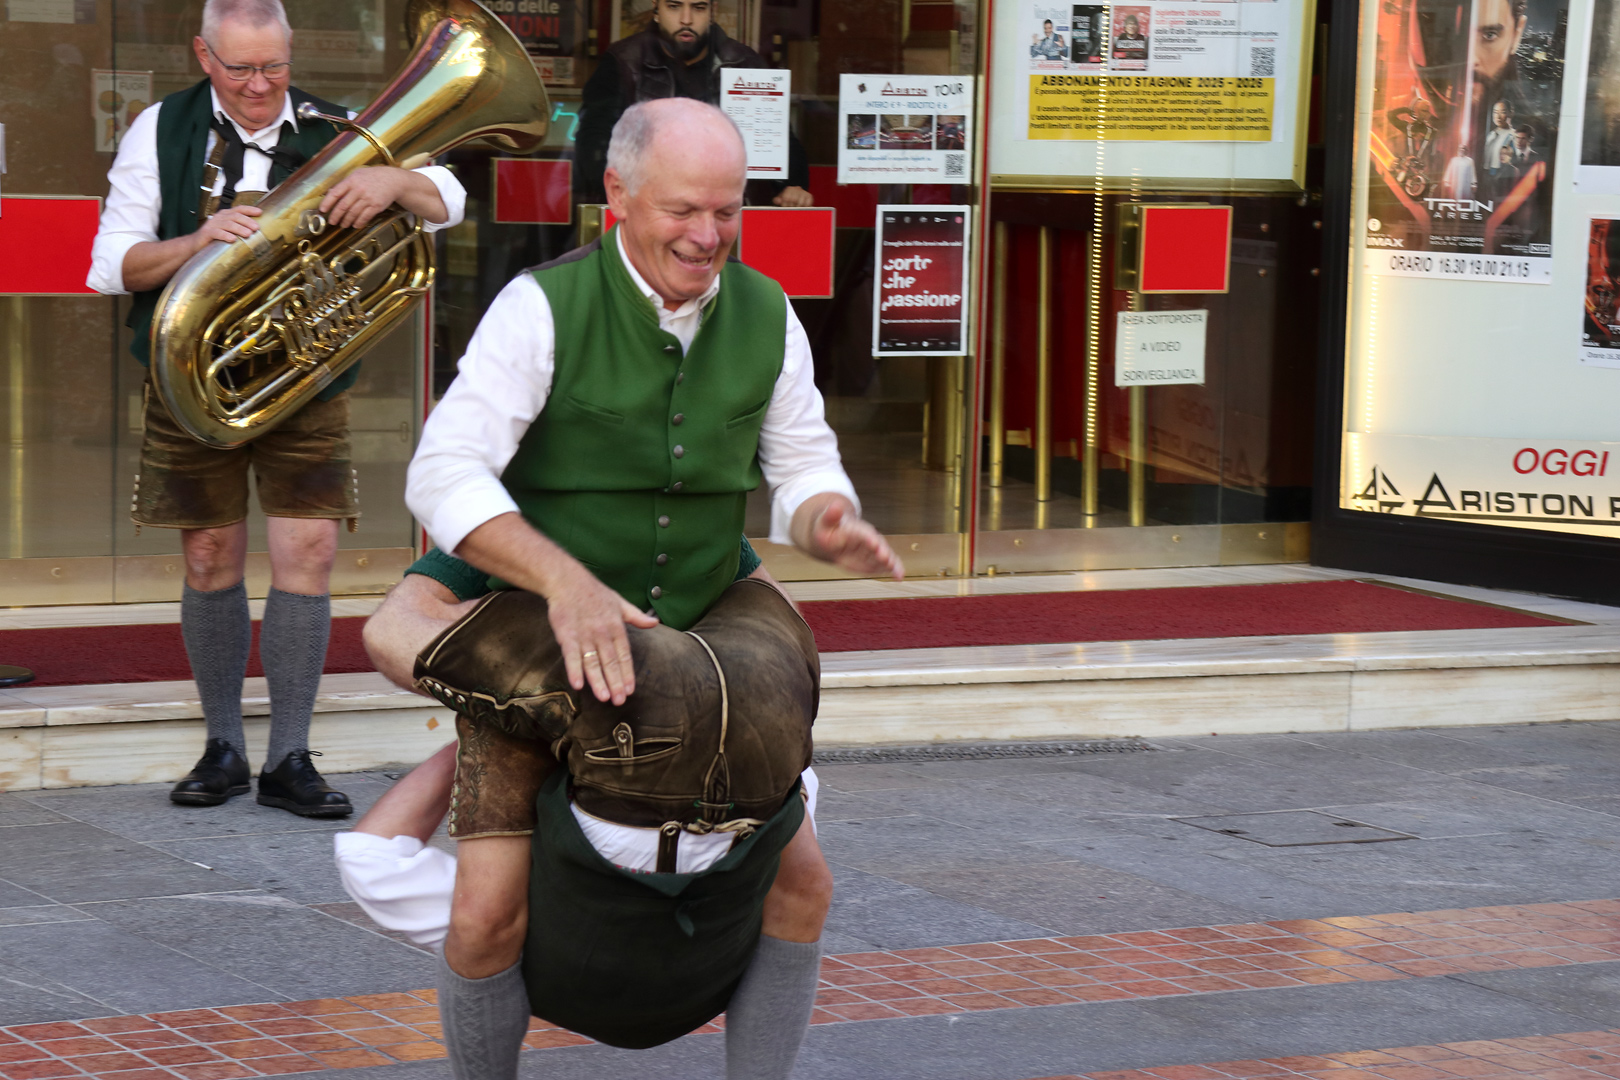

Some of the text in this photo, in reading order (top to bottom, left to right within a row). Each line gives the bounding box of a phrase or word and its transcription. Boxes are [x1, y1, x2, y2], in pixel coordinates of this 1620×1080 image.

[518, 0, 560, 14] delle
[1041, 76, 1132, 86] ABBONAMENTO
[1135, 77, 1192, 88] STAGIONE
[1197, 77, 1224, 88] 2025
[1236, 78, 1264, 88] 2026
[880, 82, 964, 96] ARISTON TOUR
[1423, 198, 1494, 213] TRON
[1432, 212, 1483, 220] ARES
[1367, 237, 1404, 247] IMAX
[1390, 256, 1530, 277] ORARIO 16.30 19.00 21.15
[1122, 314, 1203, 325] AREA SOTTOPOSTA
[1140, 342, 1181, 352] A VIDEO
[1123, 369, 1198, 381] SORVEGLIANZA
[1513, 448, 1609, 476] OGGI
[1413, 472, 1594, 516] ARISTON
